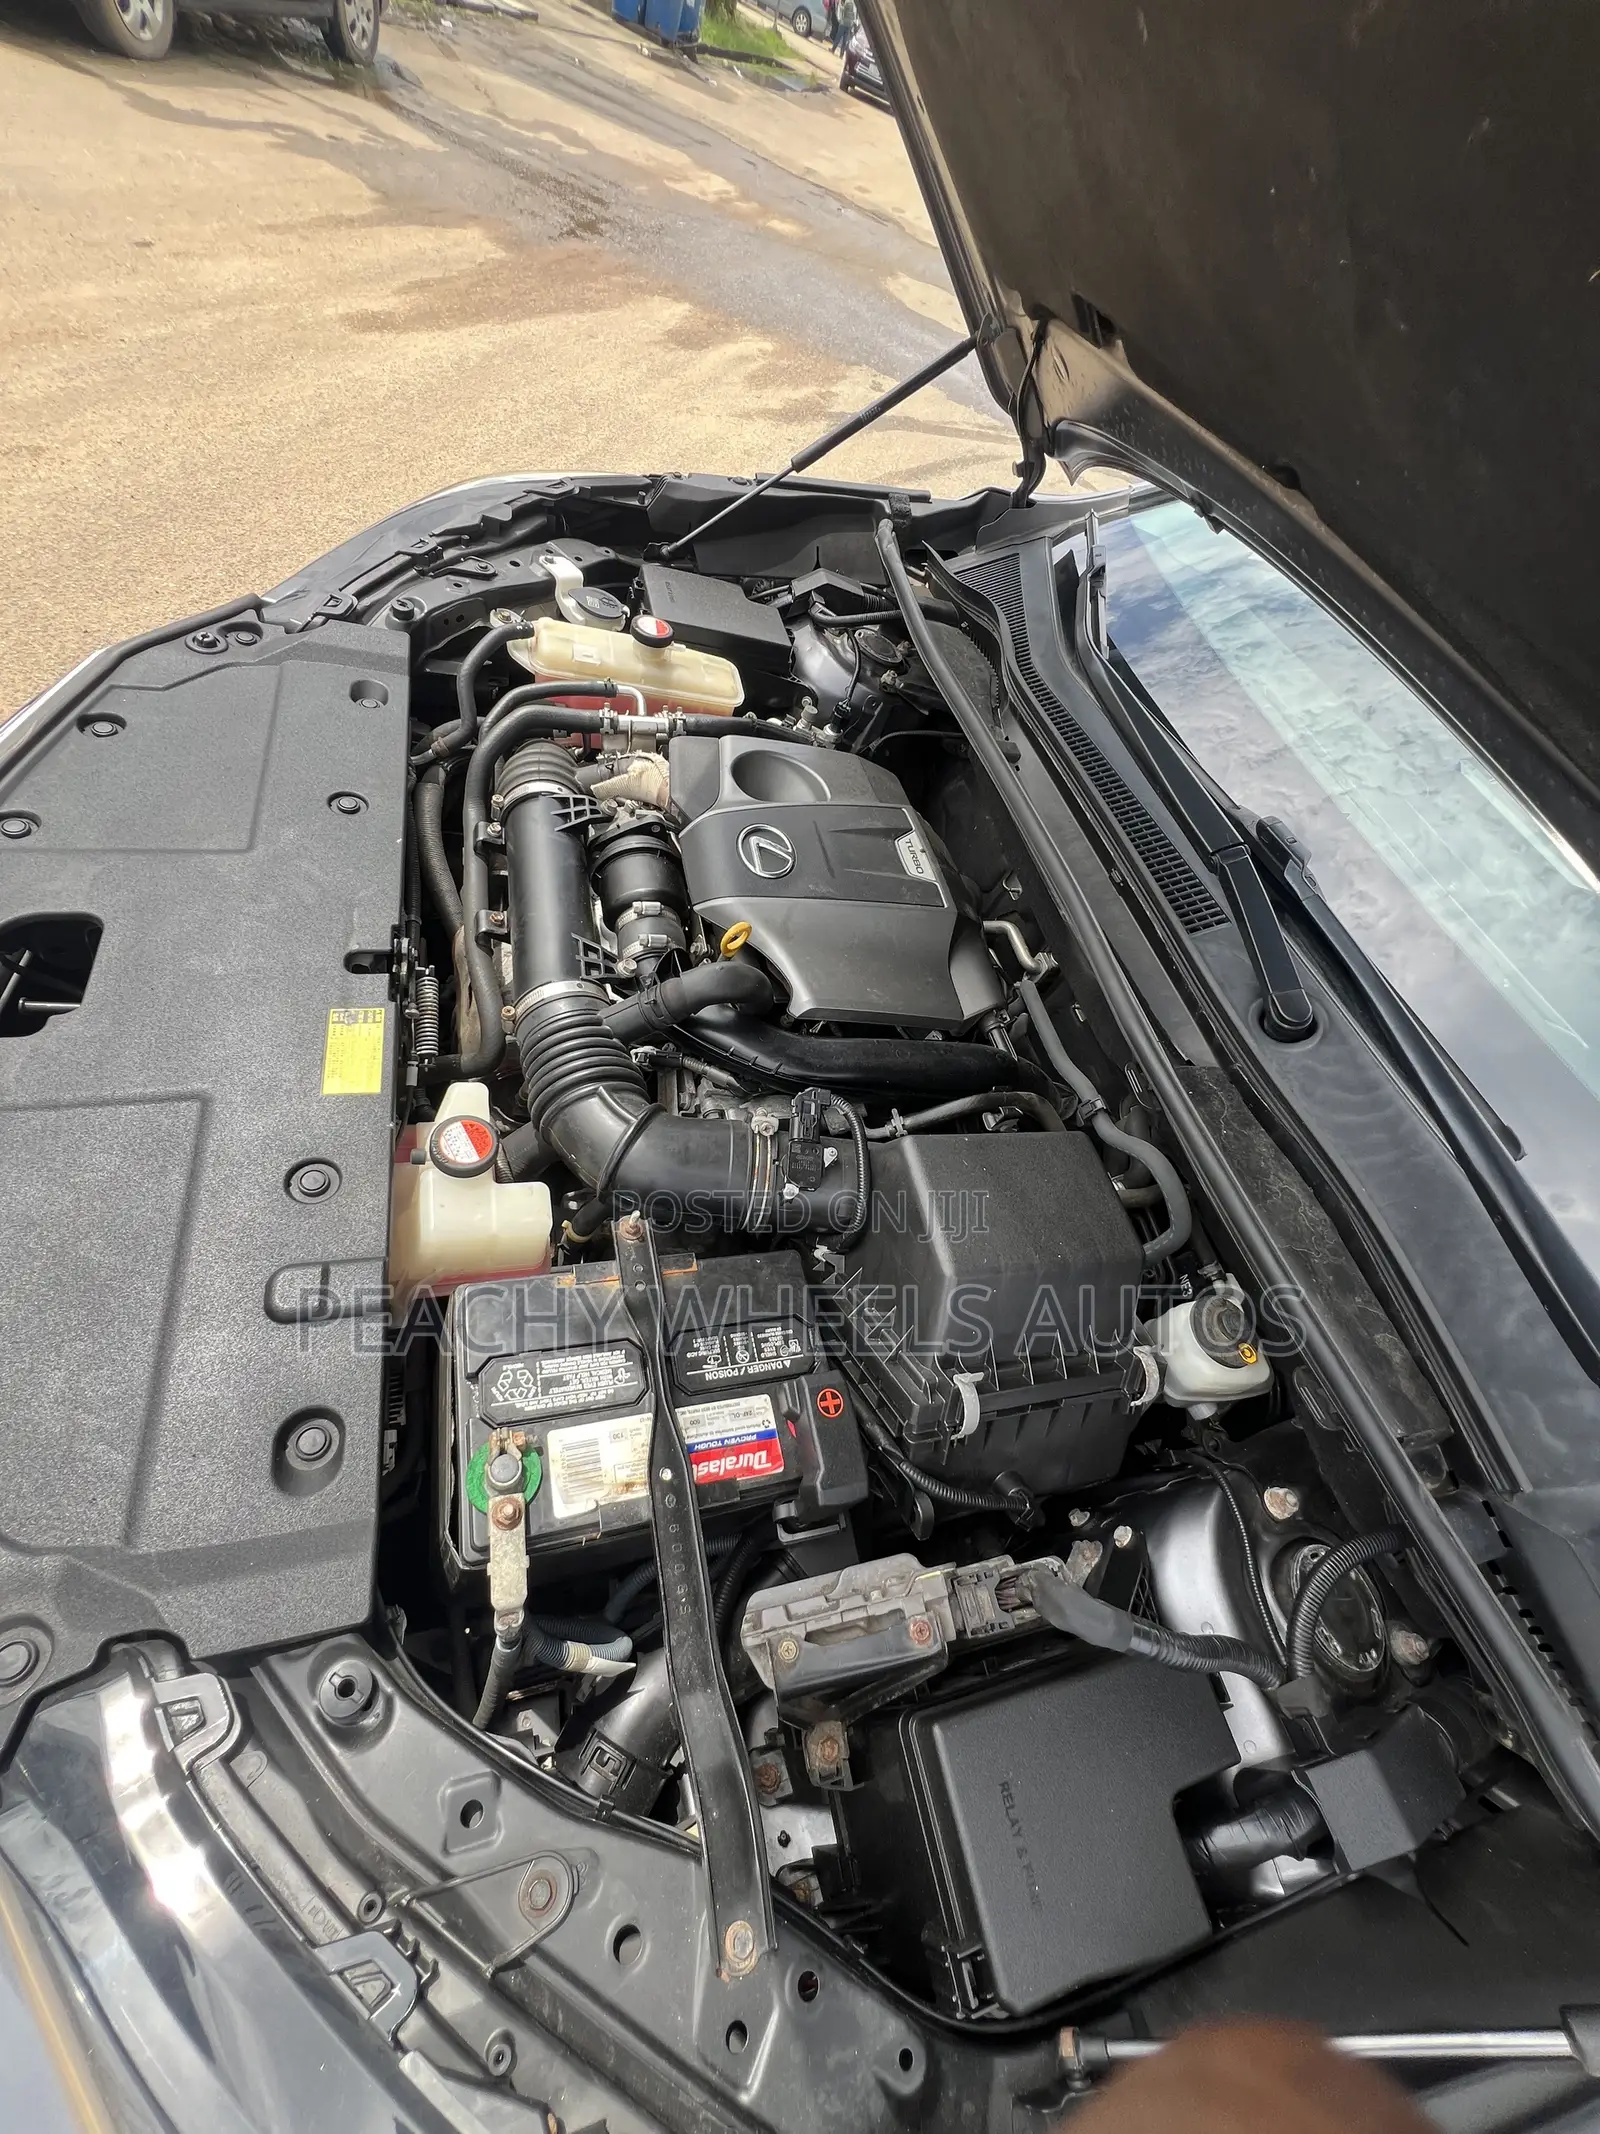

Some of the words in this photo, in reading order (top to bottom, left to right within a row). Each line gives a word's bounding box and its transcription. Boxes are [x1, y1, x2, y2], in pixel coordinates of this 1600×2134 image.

[905, 838, 924, 874] TURBO
[1179, 1273, 1193, 1297] NE3
[705, 1367, 739, 1381] POISON
[747, 1358, 783, 1374] DANGER
[694, 1438, 722, 1450] TOUGH
[723, 1433, 757, 1444] PROVEN
[998, 1780, 1022, 1837] RELAY
